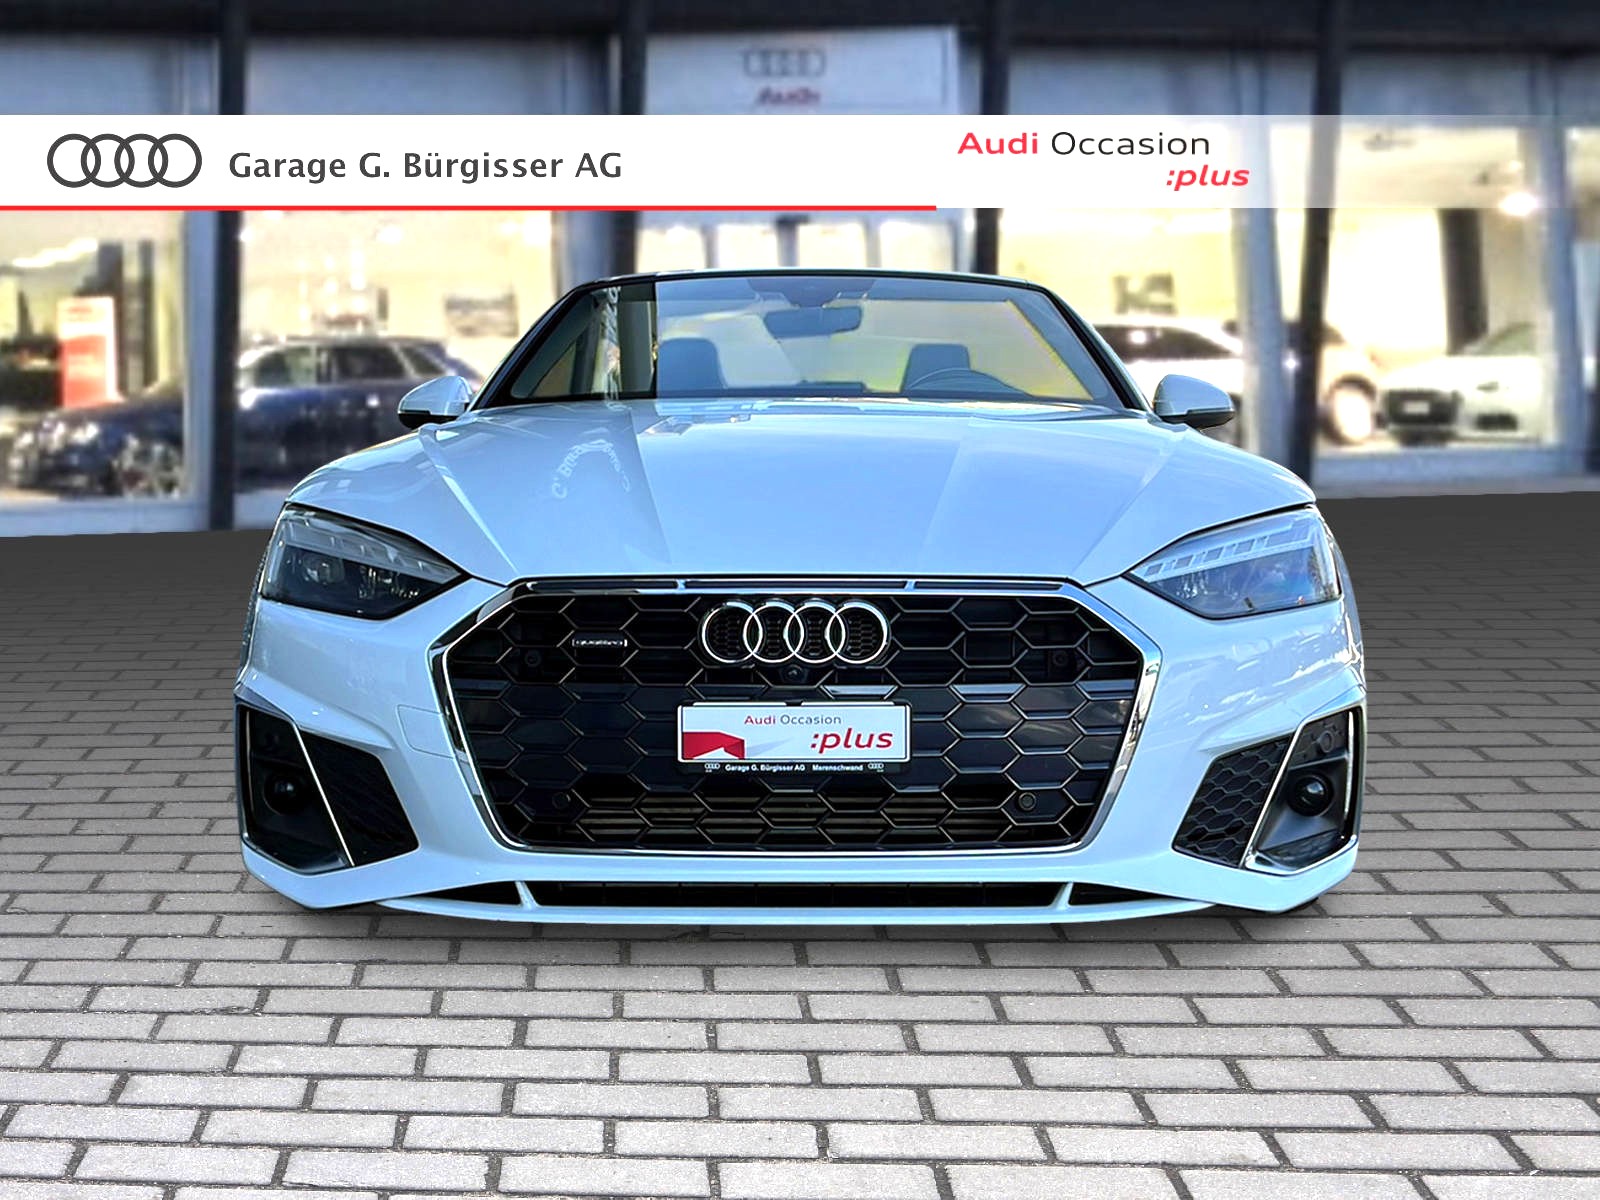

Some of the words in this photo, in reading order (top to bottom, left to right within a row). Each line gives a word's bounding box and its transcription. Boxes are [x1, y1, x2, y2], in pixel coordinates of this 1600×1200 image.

[744, 714, 776, 725] Audi
[780, 714, 842, 725] Occasion
[810, 727, 893, 754] :plus
[725, 764, 750, 773] Garage
[794, 764, 806, 772] AG
[812, 764, 864, 772] Merenschwand
